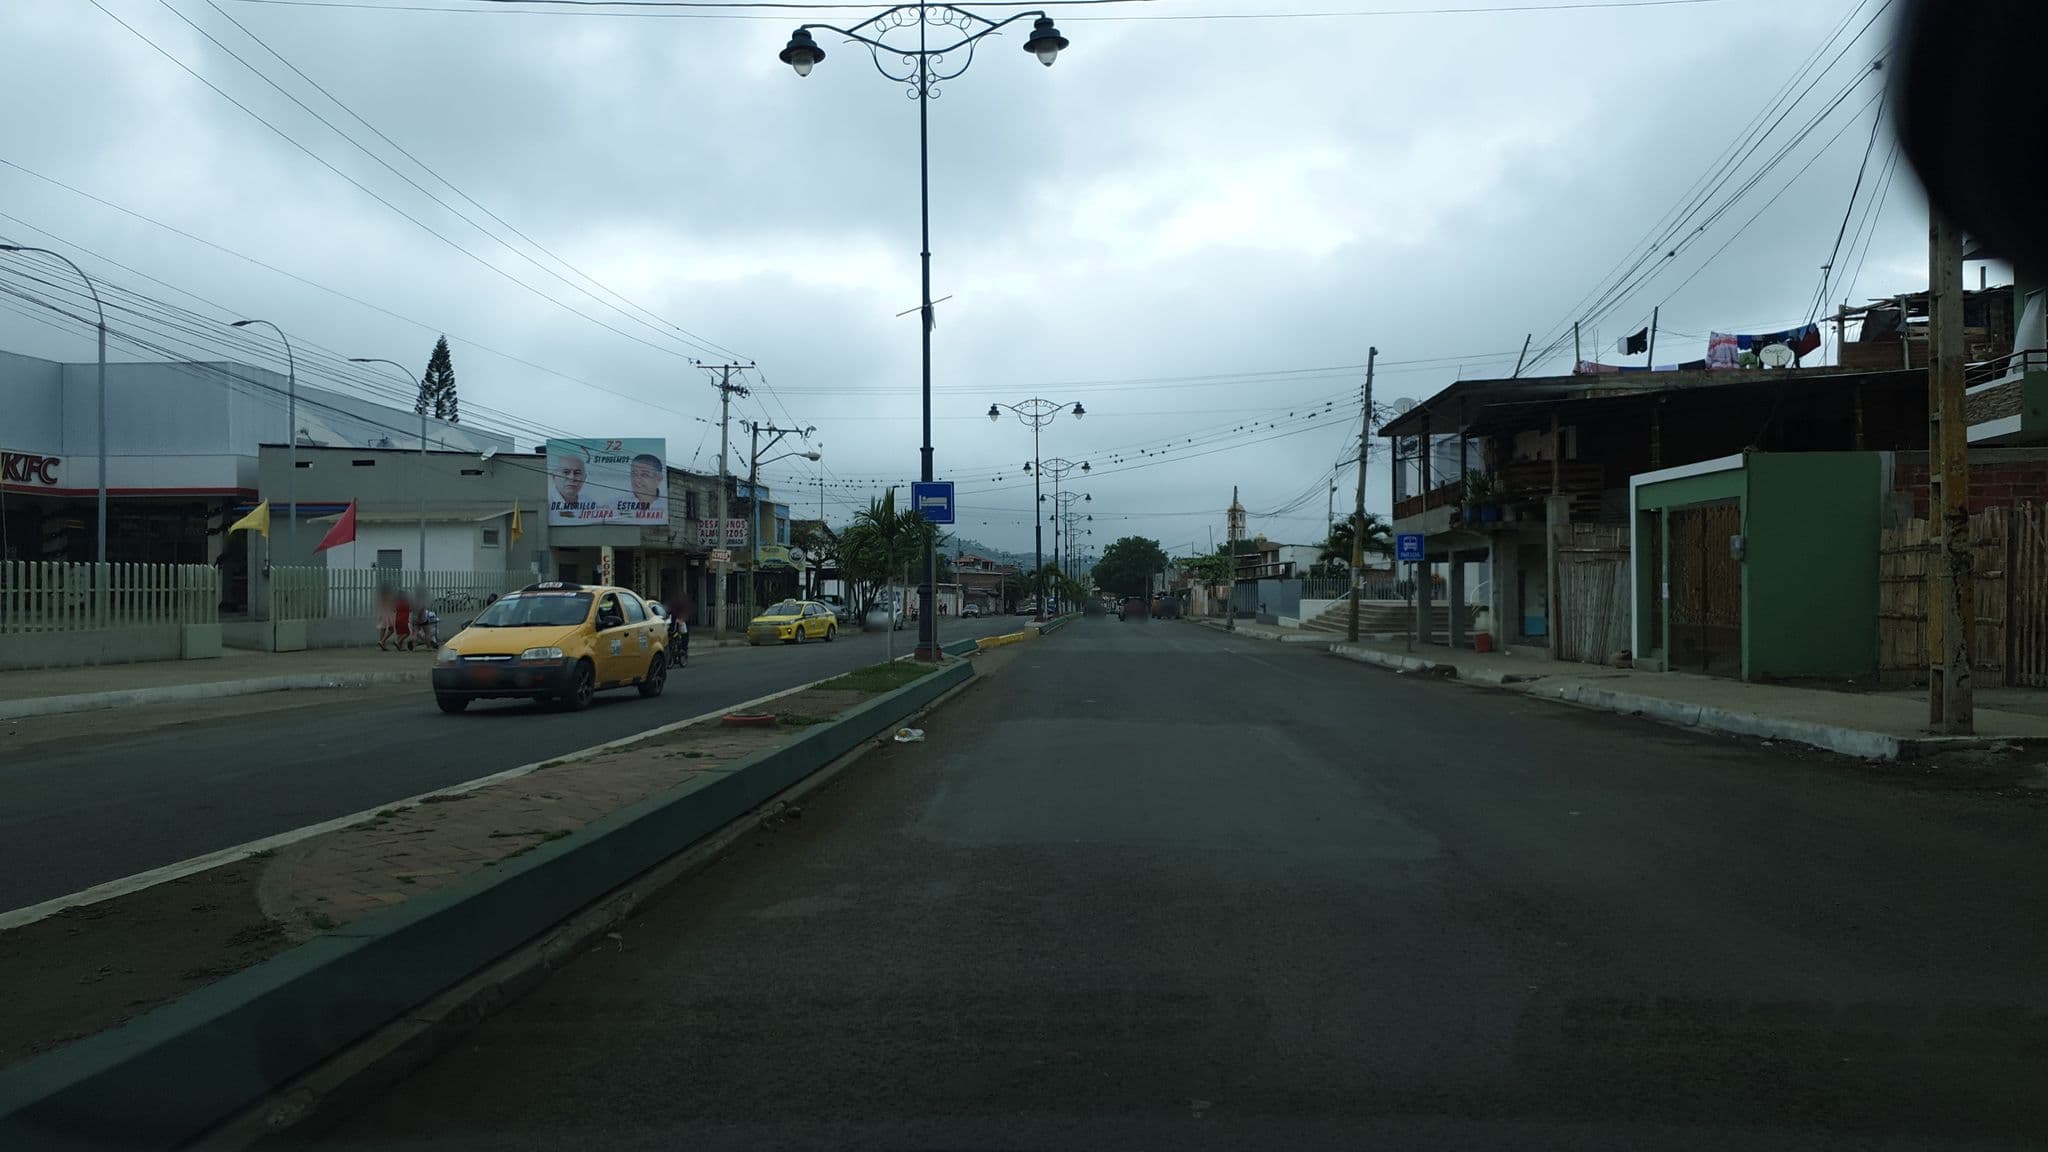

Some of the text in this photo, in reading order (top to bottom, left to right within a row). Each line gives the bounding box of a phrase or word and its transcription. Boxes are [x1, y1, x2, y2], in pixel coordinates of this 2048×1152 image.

[605, 440, 623, 451] 72
[1, 452, 60, 485] KFC
[617, 500, 651, 511] ESTRADA
[578, 510, 613, 519] JIPIJAPA
